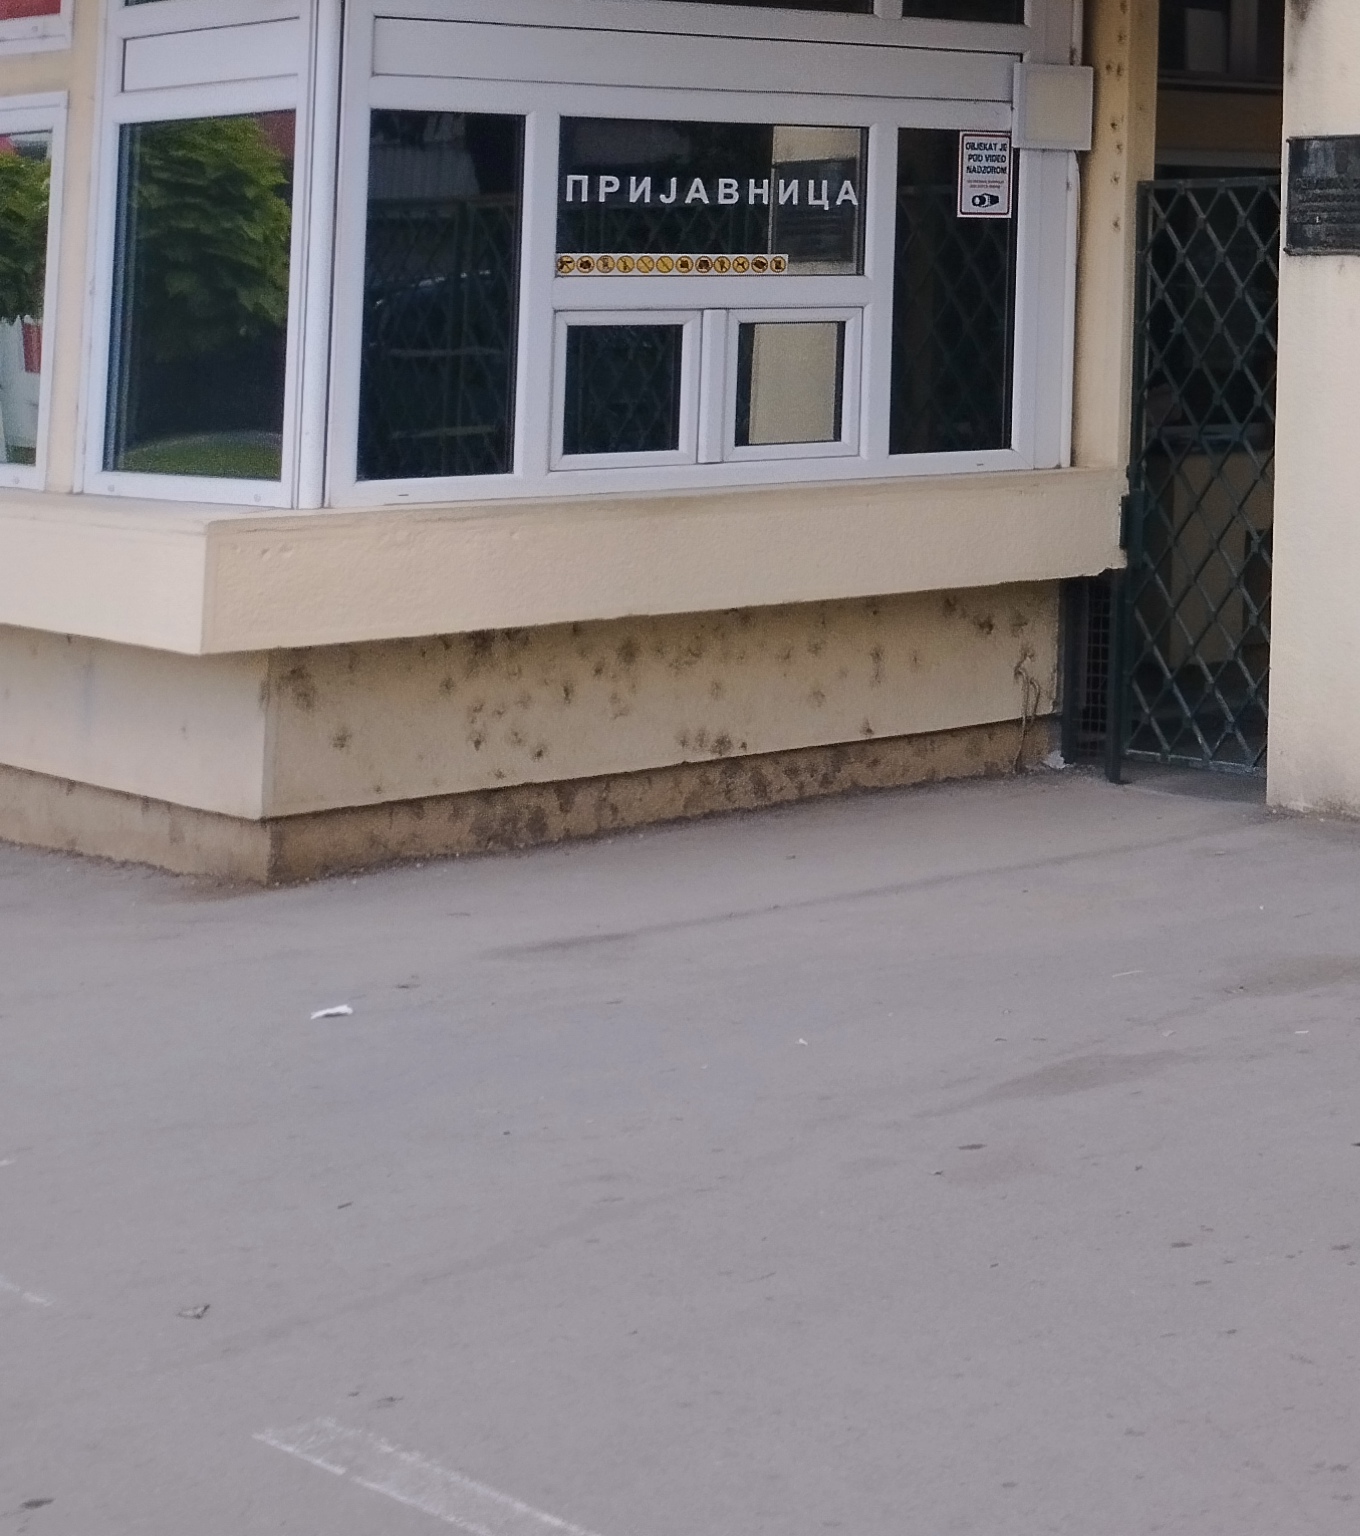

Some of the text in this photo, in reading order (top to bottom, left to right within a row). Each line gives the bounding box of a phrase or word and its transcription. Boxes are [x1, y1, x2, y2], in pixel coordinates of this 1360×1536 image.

[967, 154, 1007, 164] POD VIDEO
[966, 165, 1008, 175] NADZOROM
[565, 174, 859, 210] ПРИЈАВНИЦА
